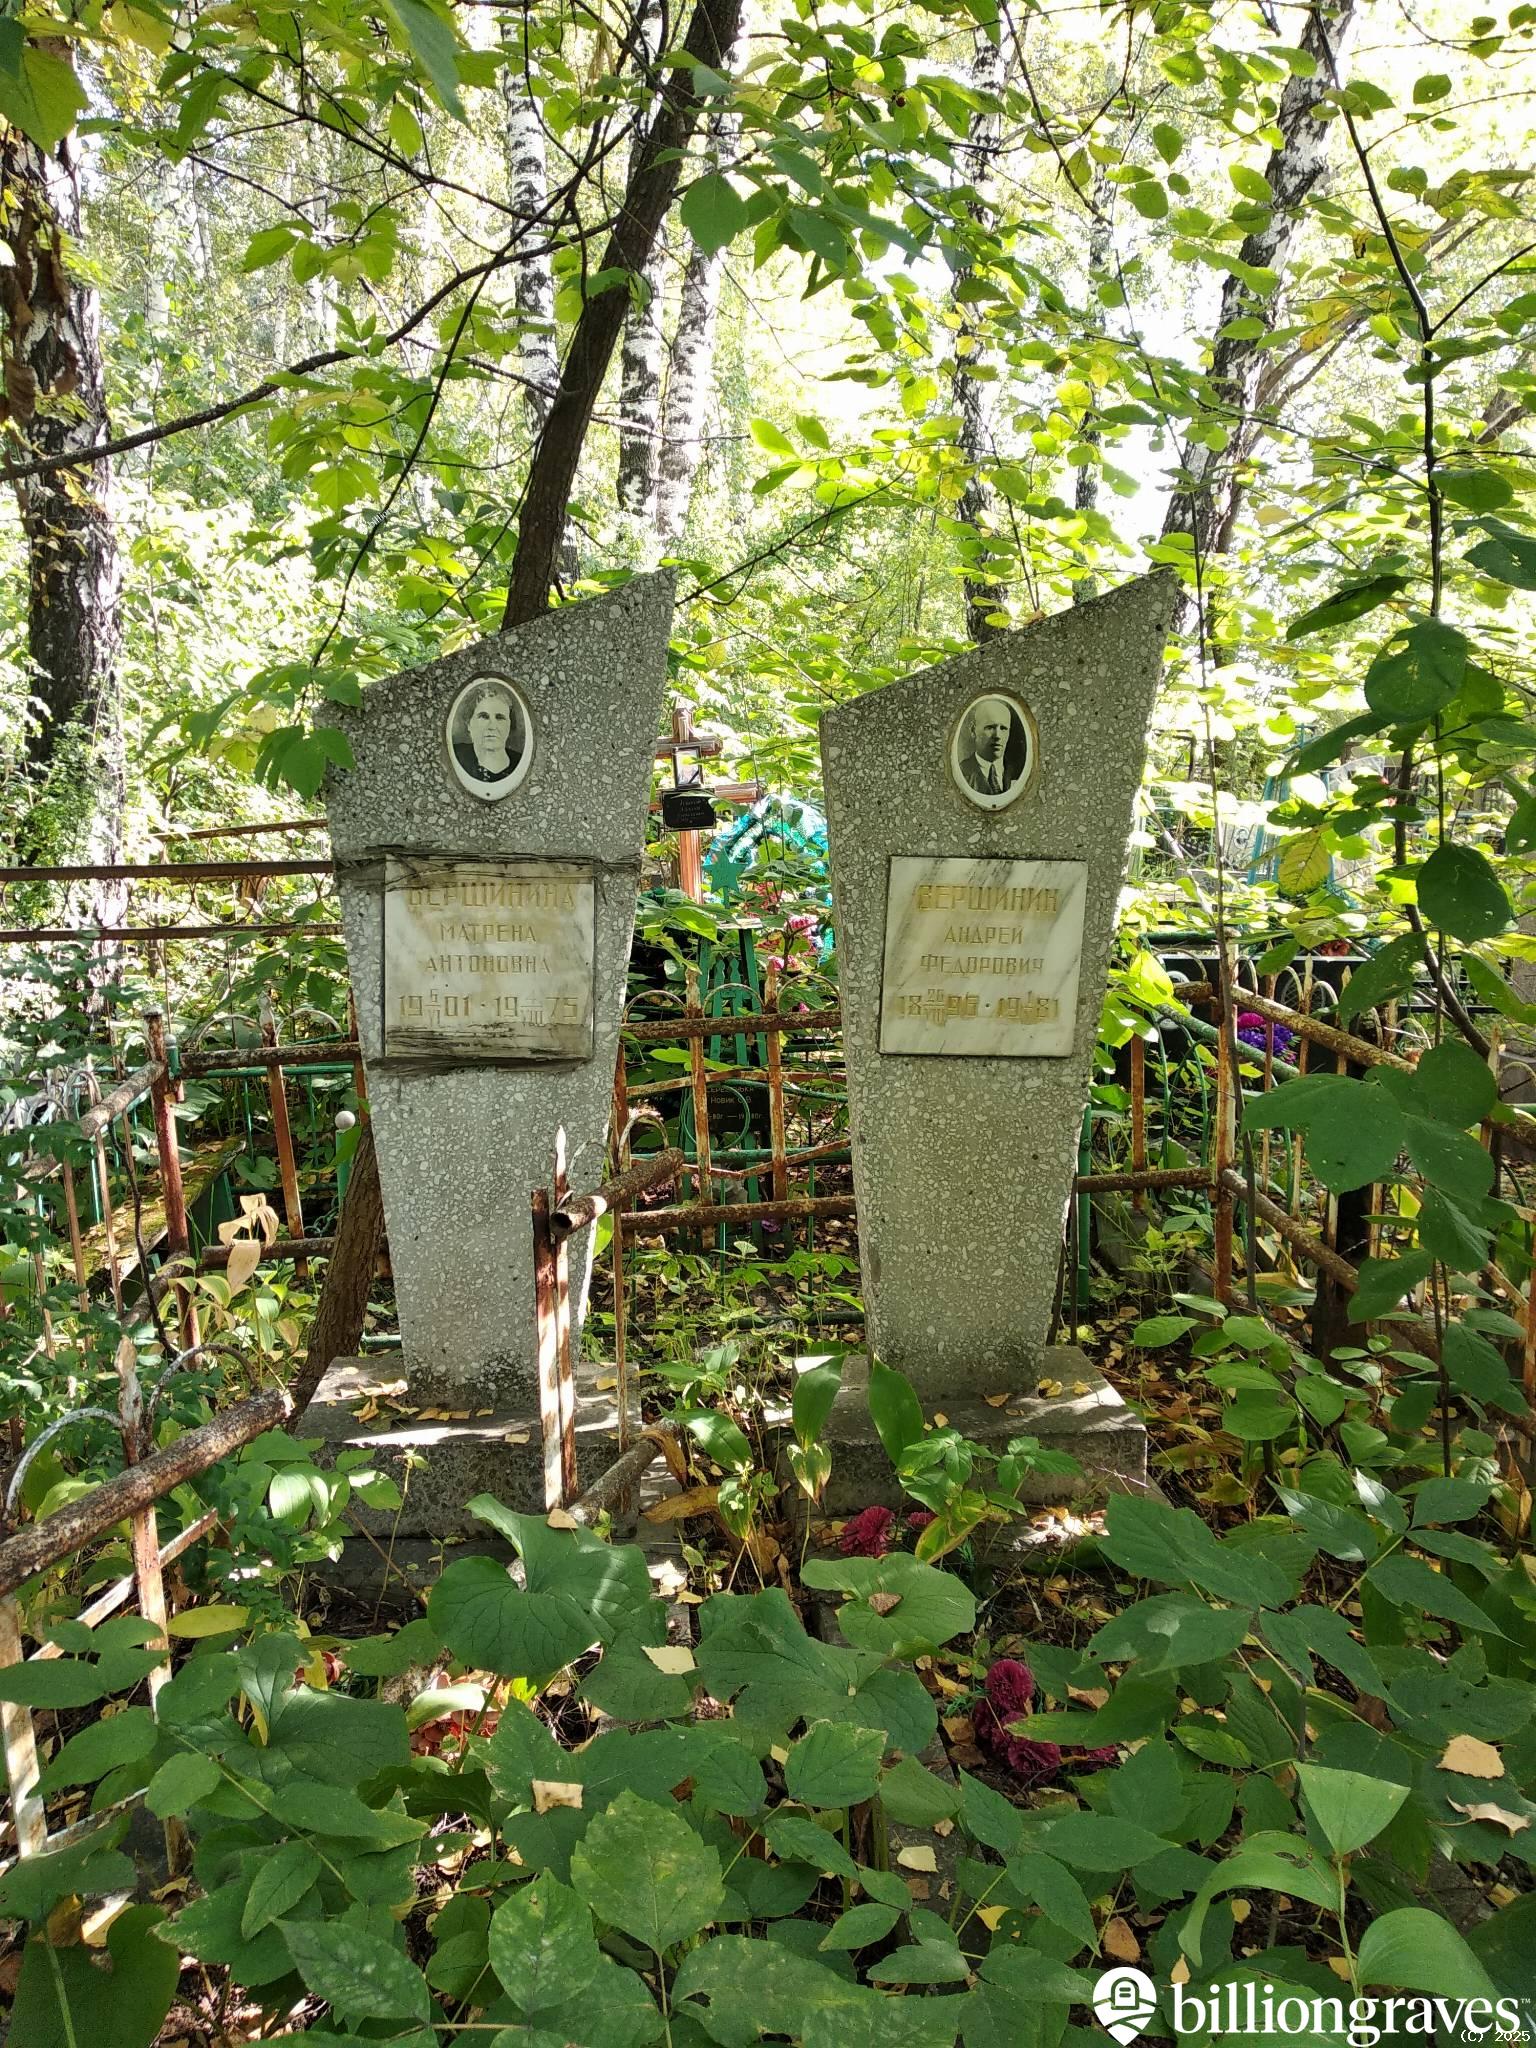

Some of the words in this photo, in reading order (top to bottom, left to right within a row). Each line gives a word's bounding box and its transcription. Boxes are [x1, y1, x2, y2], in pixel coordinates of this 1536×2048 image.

[407, 882, 577, 911] ВЕРШИНИНА
[918, 884, 1059, 912] ВЕРШИНИН
[440, 923, 538, 942] МАТРЕНА
[944, 925, 1023, 945] АНДРЕЙ
[425, 954, 551, 974] АНТОНОВНА
[919, 954, 1045, 977] ФЕДОРОВИЧ
